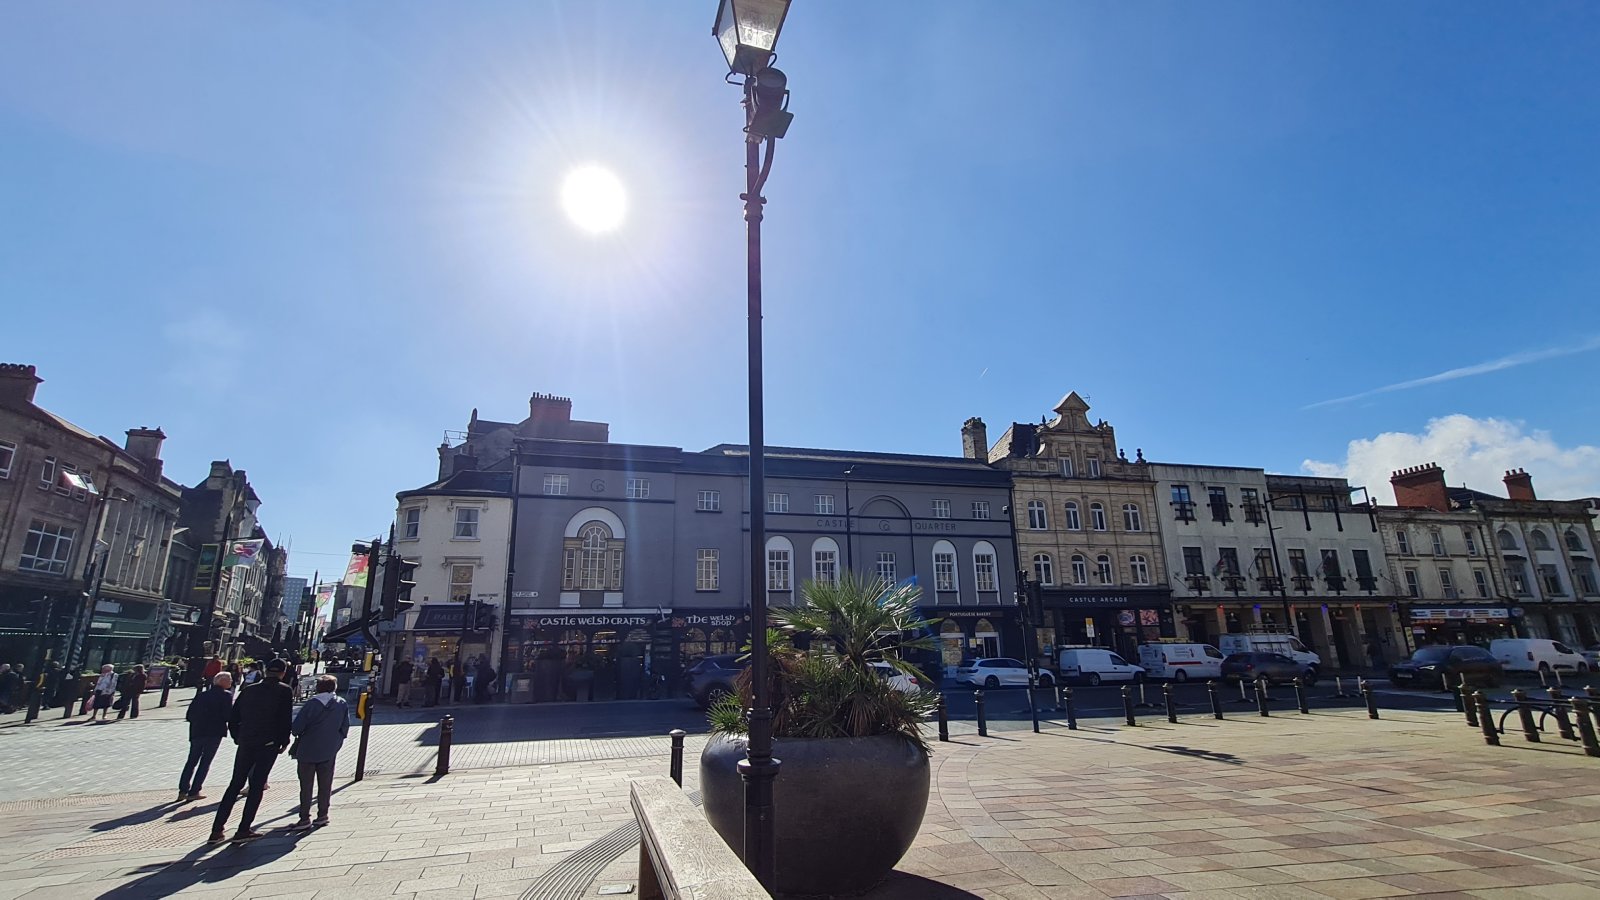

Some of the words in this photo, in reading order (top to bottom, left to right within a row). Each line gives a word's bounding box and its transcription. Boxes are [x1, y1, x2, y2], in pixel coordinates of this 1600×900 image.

[816, 519, 856, 528] CASTLE
[914, 522, 957, 531] QUARTER
[540, 616, 576, 626] CASTLE
[578, 616, 609, 625] WELSH
[610, 616, 646, 626] CRAFTS
